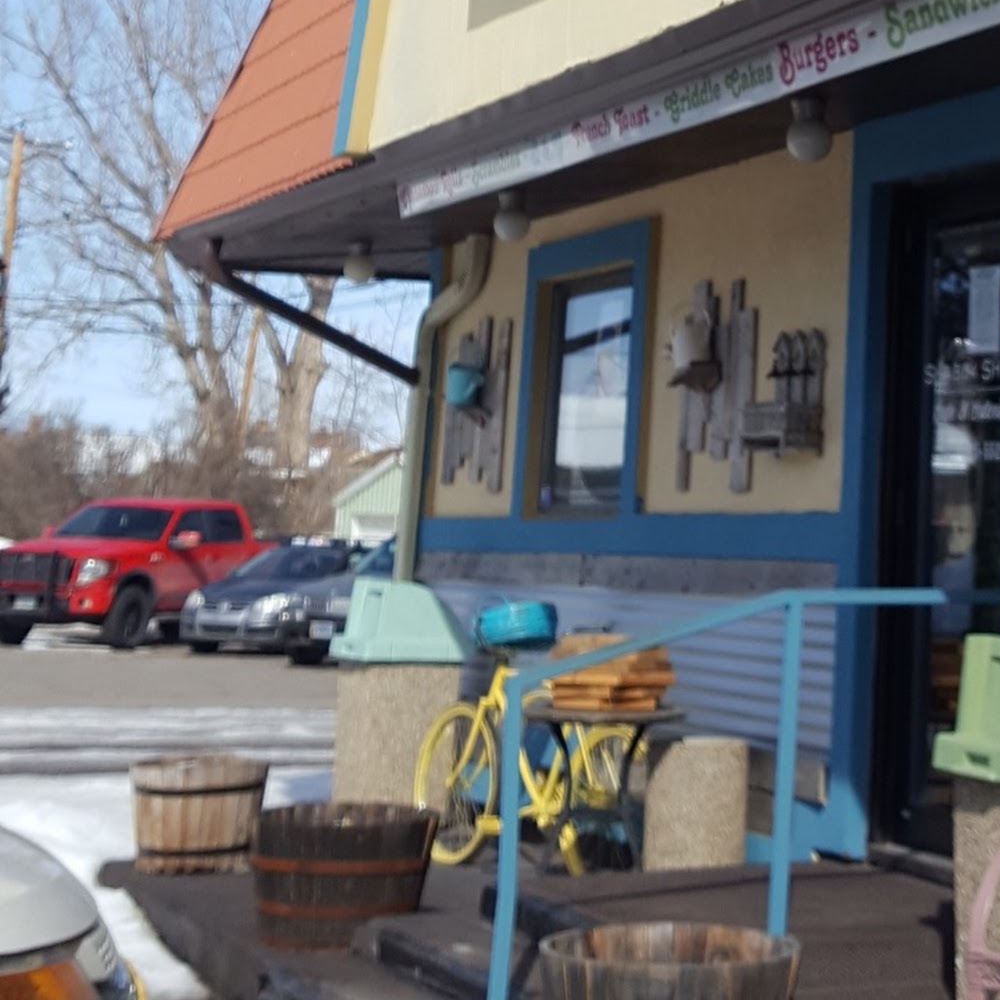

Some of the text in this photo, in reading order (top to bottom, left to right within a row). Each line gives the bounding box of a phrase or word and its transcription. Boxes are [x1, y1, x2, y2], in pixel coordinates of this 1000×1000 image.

[664, 77, 720, 123] Griddle
[725, 62, 773, 98] Cakes
[777, 23, 859, 85] Burgers
